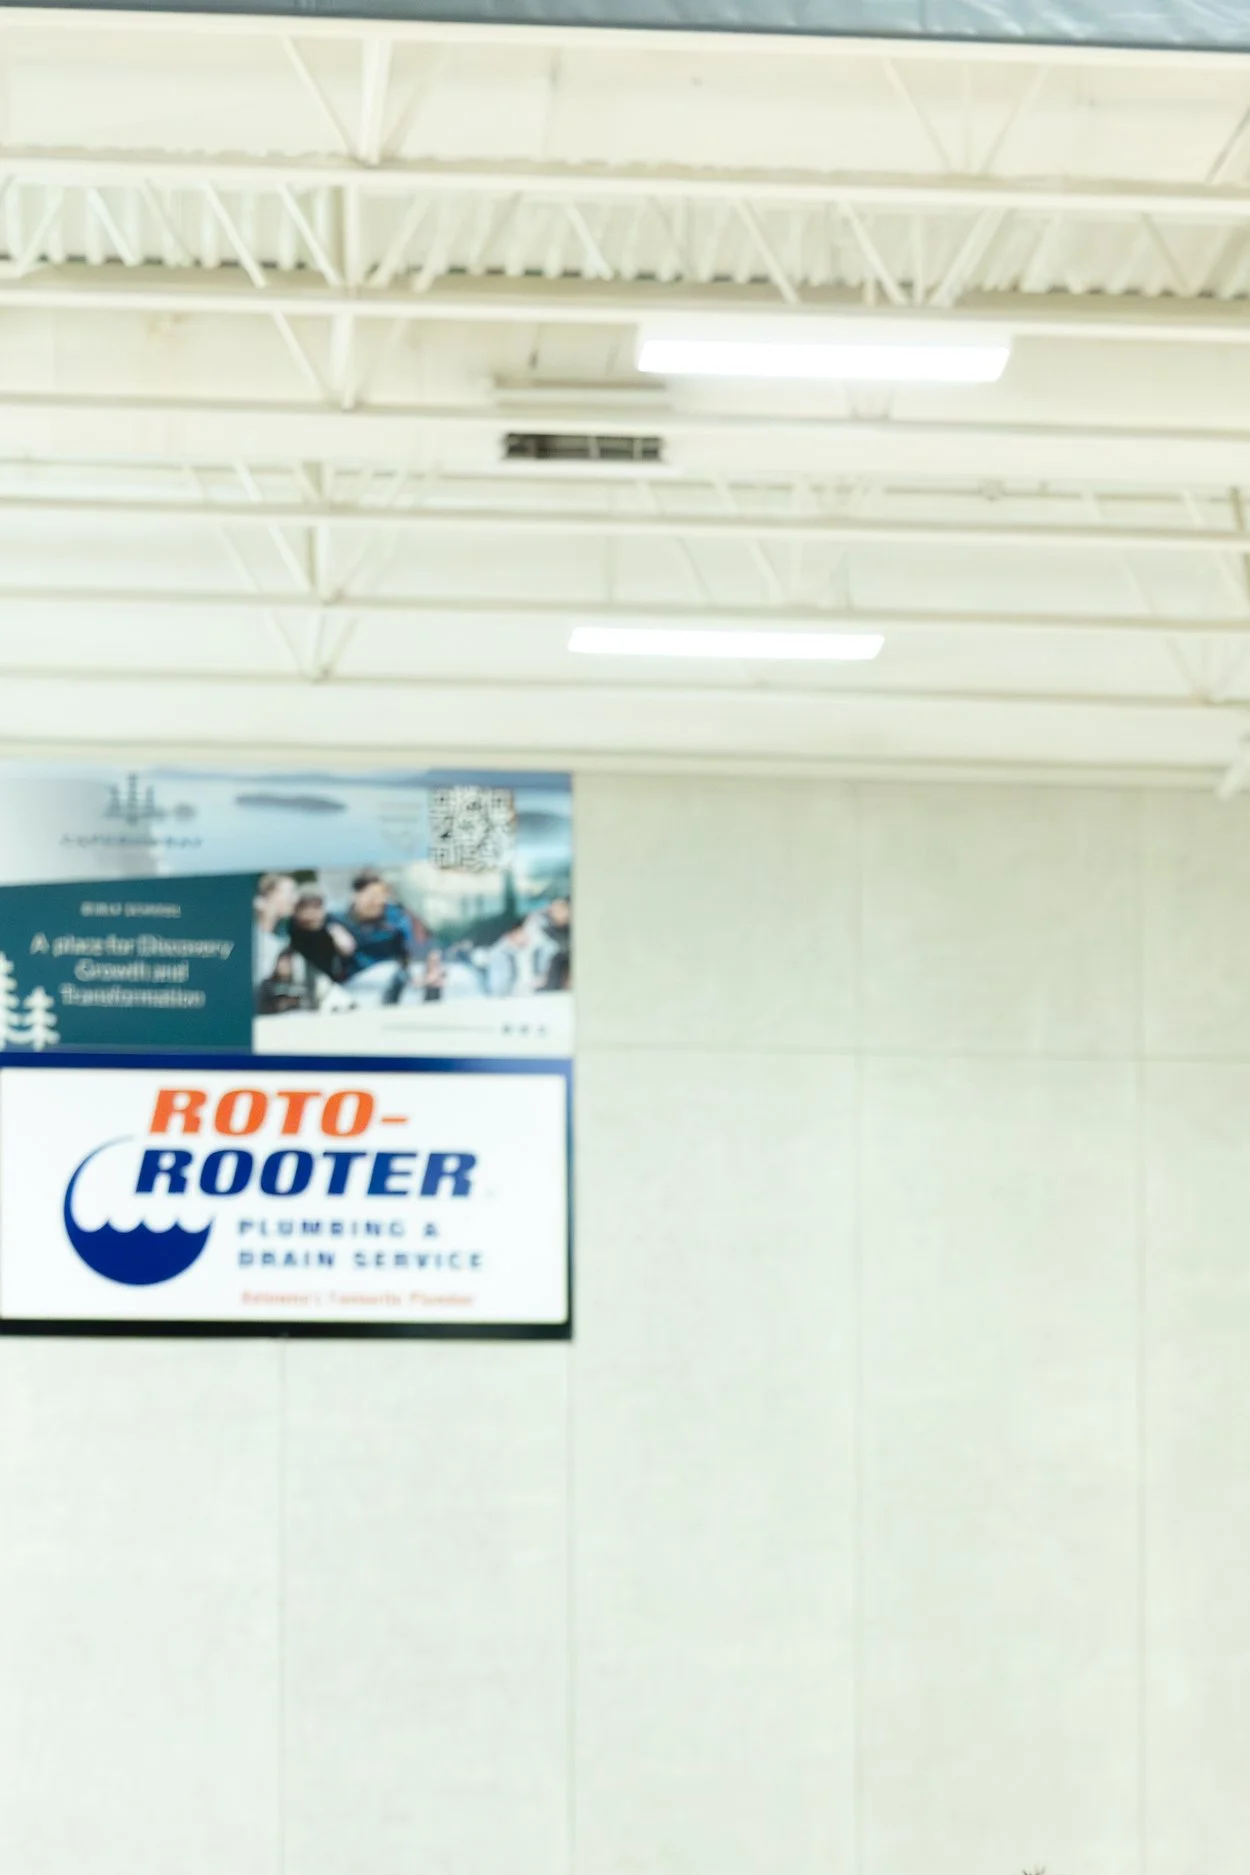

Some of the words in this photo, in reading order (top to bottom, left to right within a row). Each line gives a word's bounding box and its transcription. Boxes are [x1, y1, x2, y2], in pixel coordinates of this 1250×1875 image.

[30, 932, 50, 955] A
[52, 934, 103, 957] place
[104, 933, 135, 956] for
[136, 933, 235, 960] Discovery
[74, 957, 147, 982] Growth
[151, 959, 189, 983] and
[59, 982, 206, 1008] Transformation
[149, 1089, 409, 1137] ROTO-
[136, 1149, 477, 1197] ROOTER
[238, 1220, 404, 1237] PLUMBING
[238, 1252, 335, 1268] DRAIN
[354, 1253, 483, 1270] SERVICE
